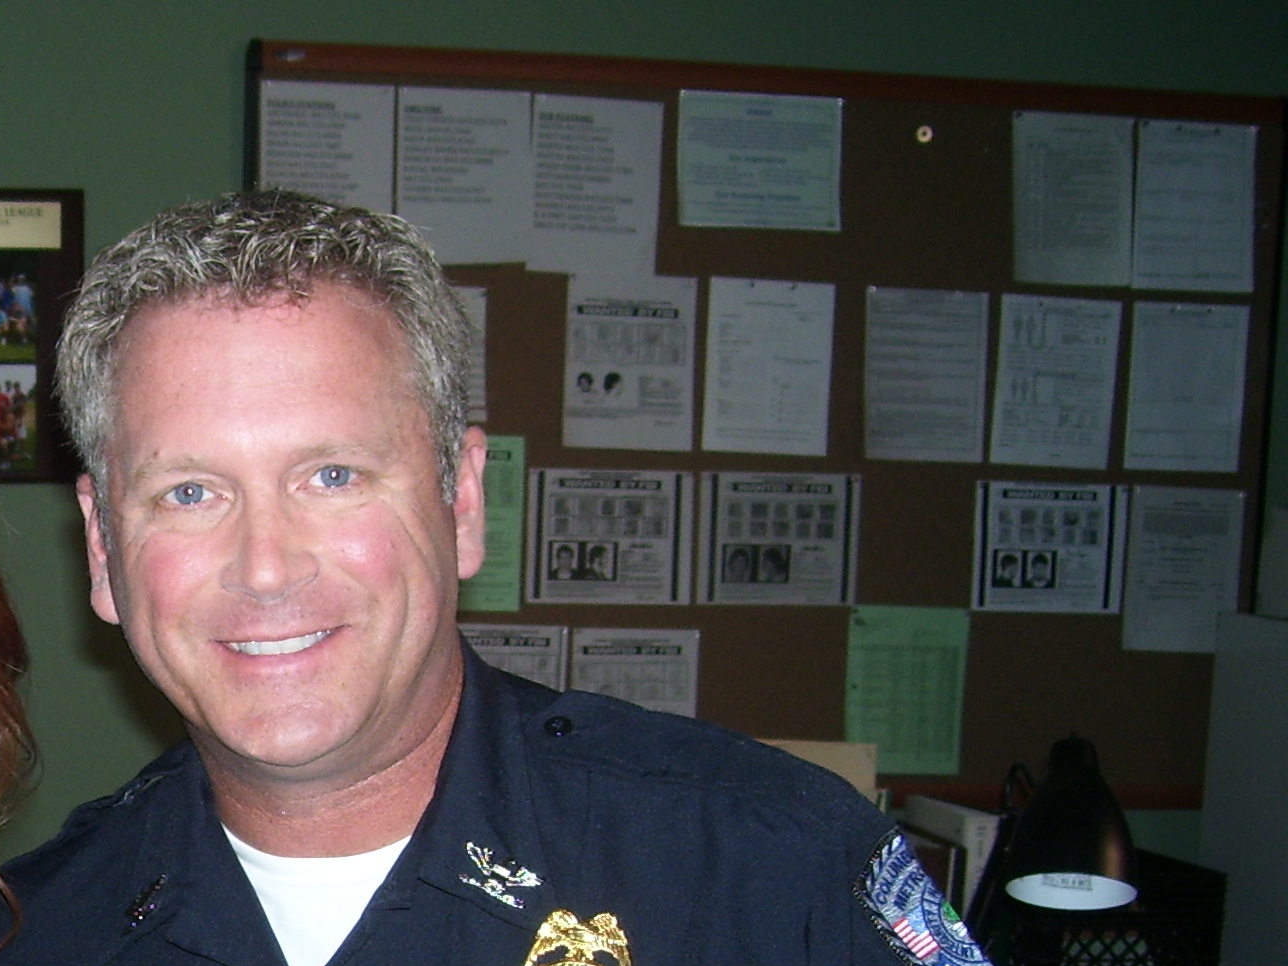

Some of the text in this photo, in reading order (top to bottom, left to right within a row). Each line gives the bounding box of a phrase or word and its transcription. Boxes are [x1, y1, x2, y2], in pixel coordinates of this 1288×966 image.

[5, 208, 43, 218] LEAGUE
[583, 305, 633, 315] WANTED
[875, 851, 914, 906] COLUMB
